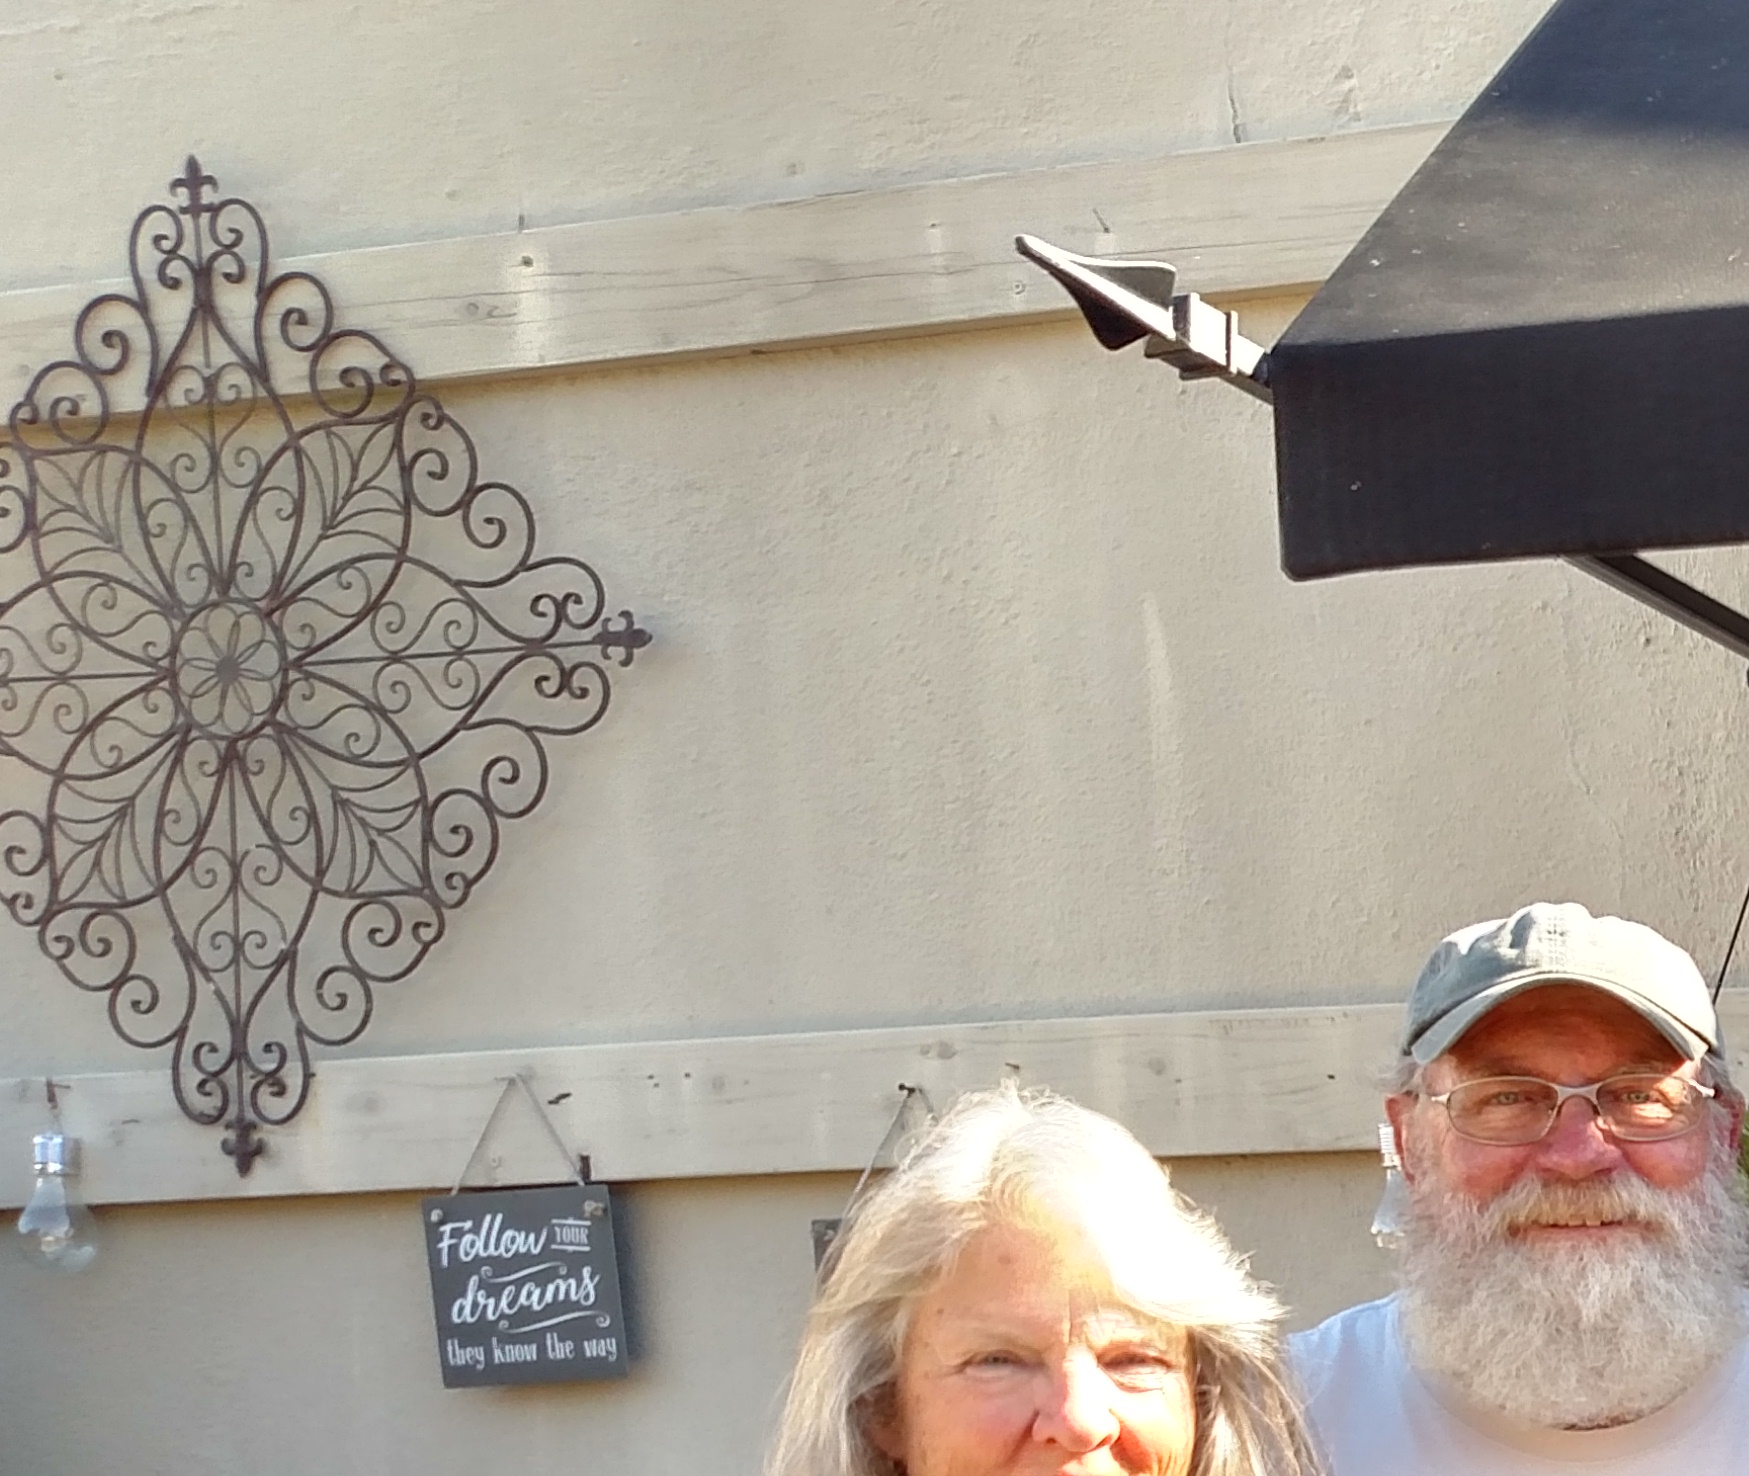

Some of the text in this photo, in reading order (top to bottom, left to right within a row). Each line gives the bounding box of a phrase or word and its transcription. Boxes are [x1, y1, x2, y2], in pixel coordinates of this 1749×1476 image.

[436, 1213, 589, 1267] Follow YOUR
[451, 1266, 601, 1324] dreams
[447, 1333, 617, 1370] they know the way
